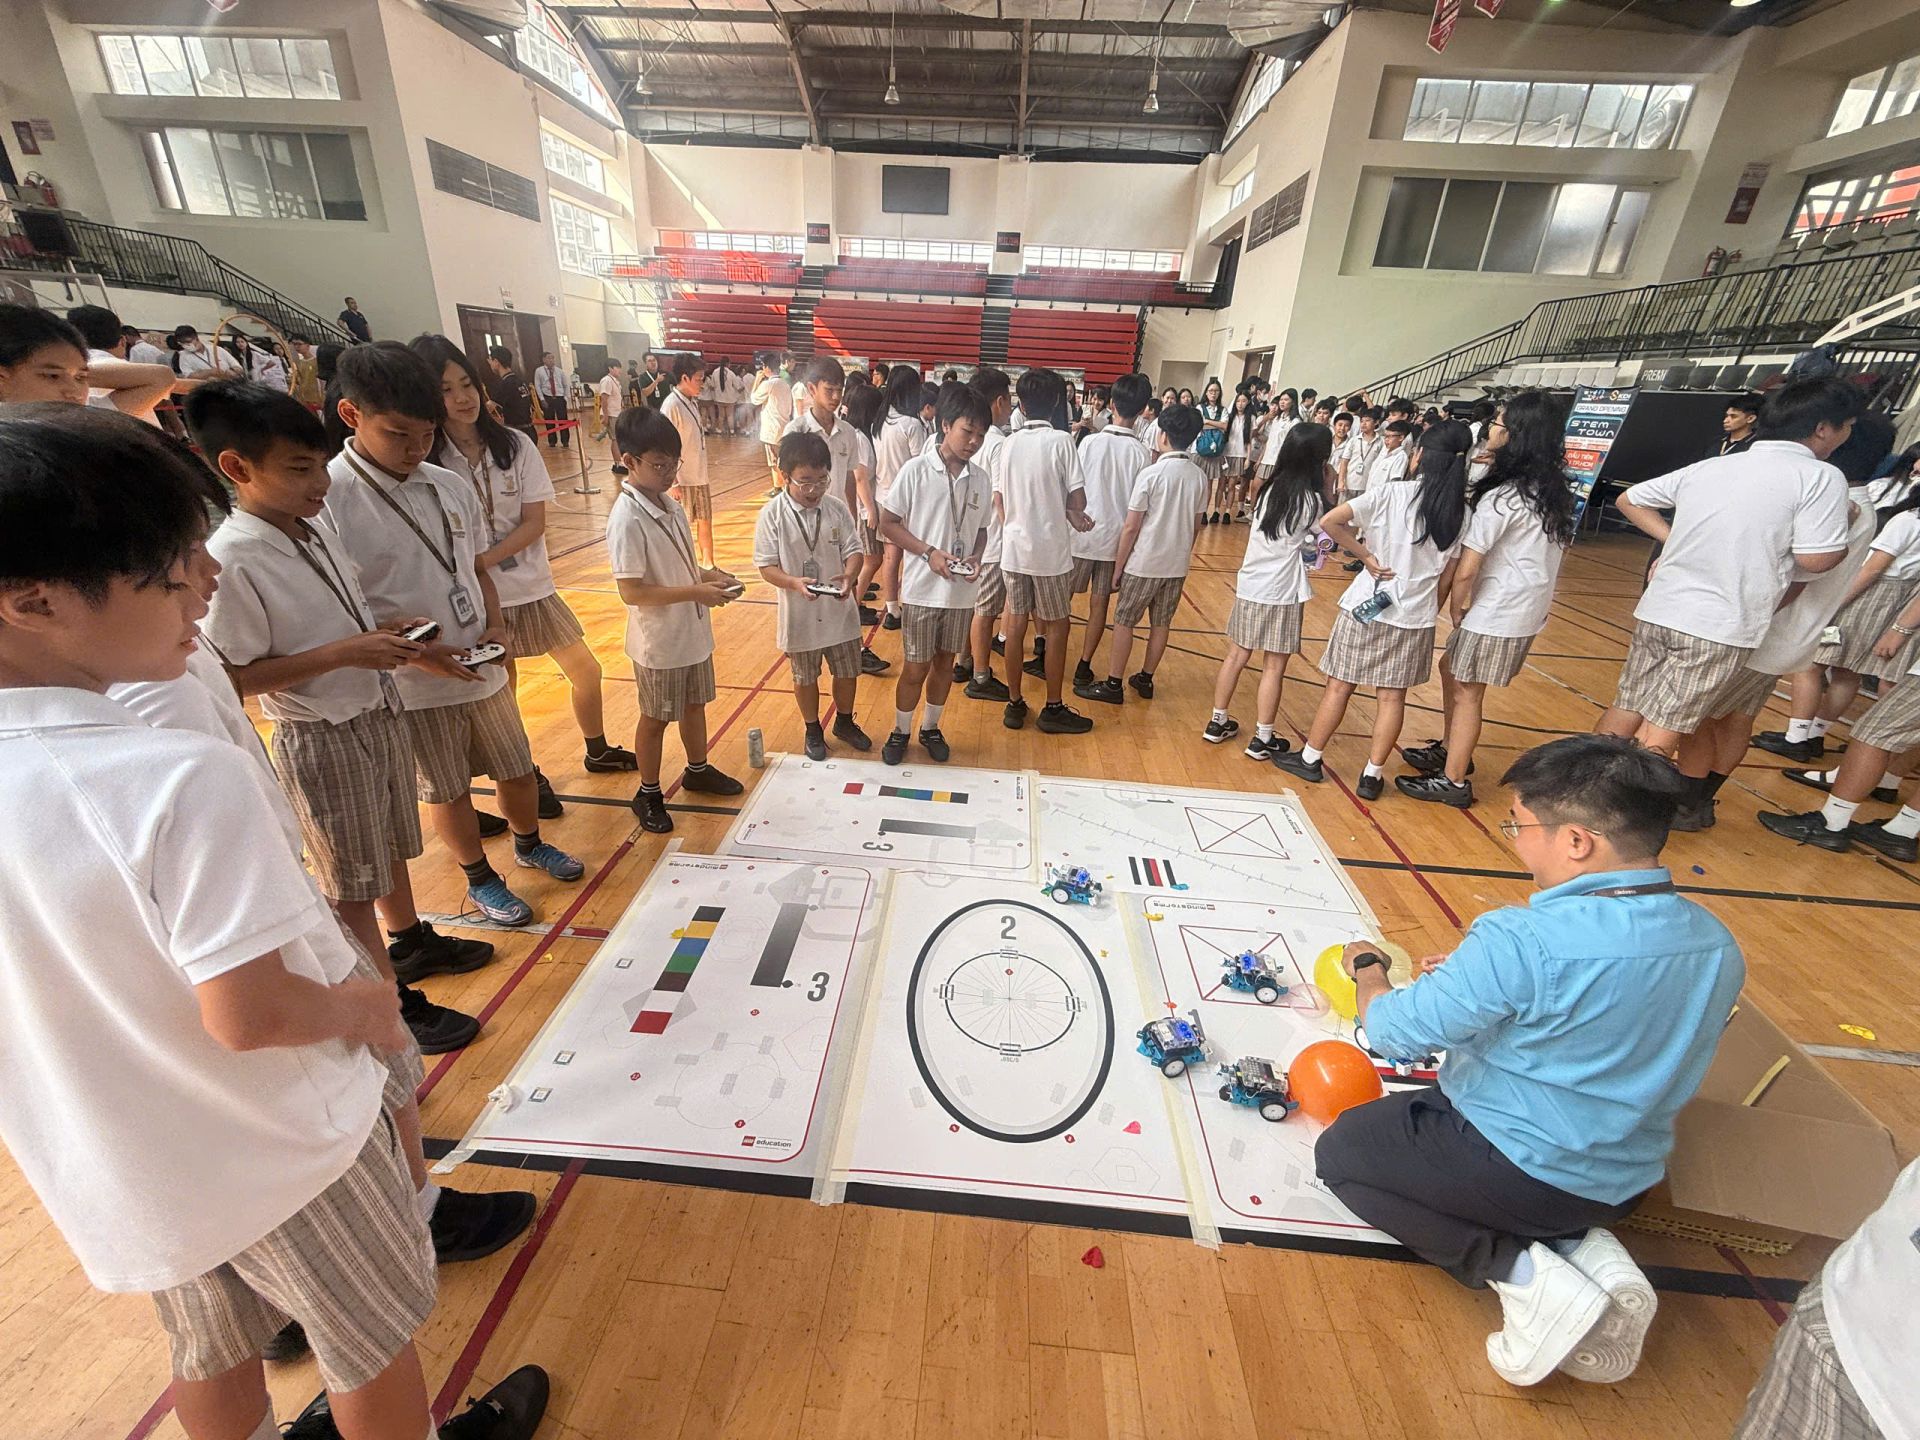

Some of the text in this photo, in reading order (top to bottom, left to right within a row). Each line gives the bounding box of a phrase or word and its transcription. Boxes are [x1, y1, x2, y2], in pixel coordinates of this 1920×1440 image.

[1570, 420, 1609, 428] STEM
[1577, 428, 1614, 437] TOWN
[863, 842, 893, 851] 3
[1001, 916, 1016, 940] 2
[807, 972, 830, 1001] 3
[756, 1139, 792, 1148] education
